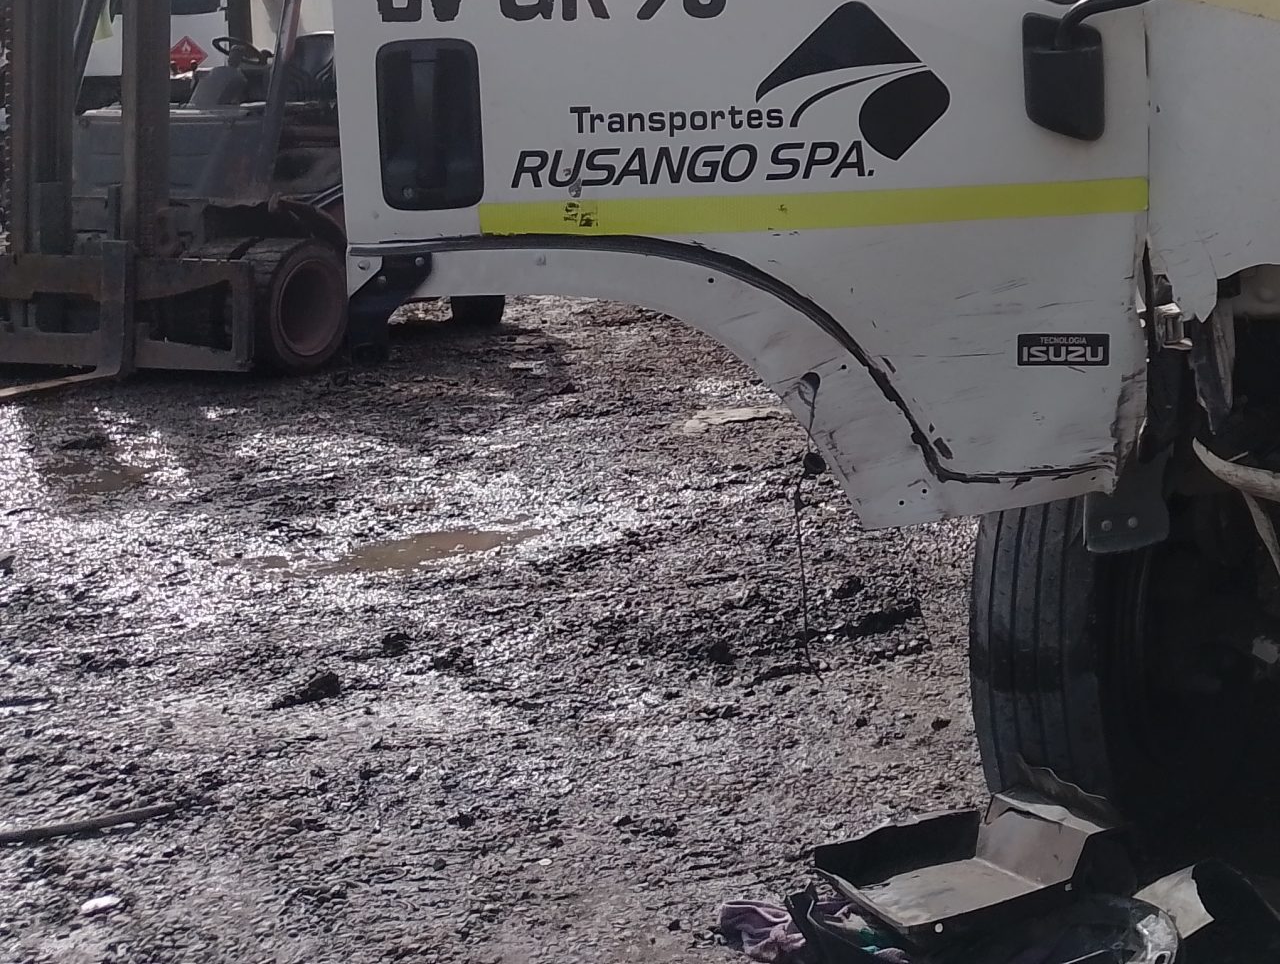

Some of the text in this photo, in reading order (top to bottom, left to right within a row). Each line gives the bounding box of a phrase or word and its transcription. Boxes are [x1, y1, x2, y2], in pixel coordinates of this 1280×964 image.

[570, 106, 784, 137] Transportes
[511, 140, 875, 189] RUSANGO SPA.
[1040, 336, 1087, 344] TECNOLOGIA
[1022, 346, 1104, 362] ISUZU
